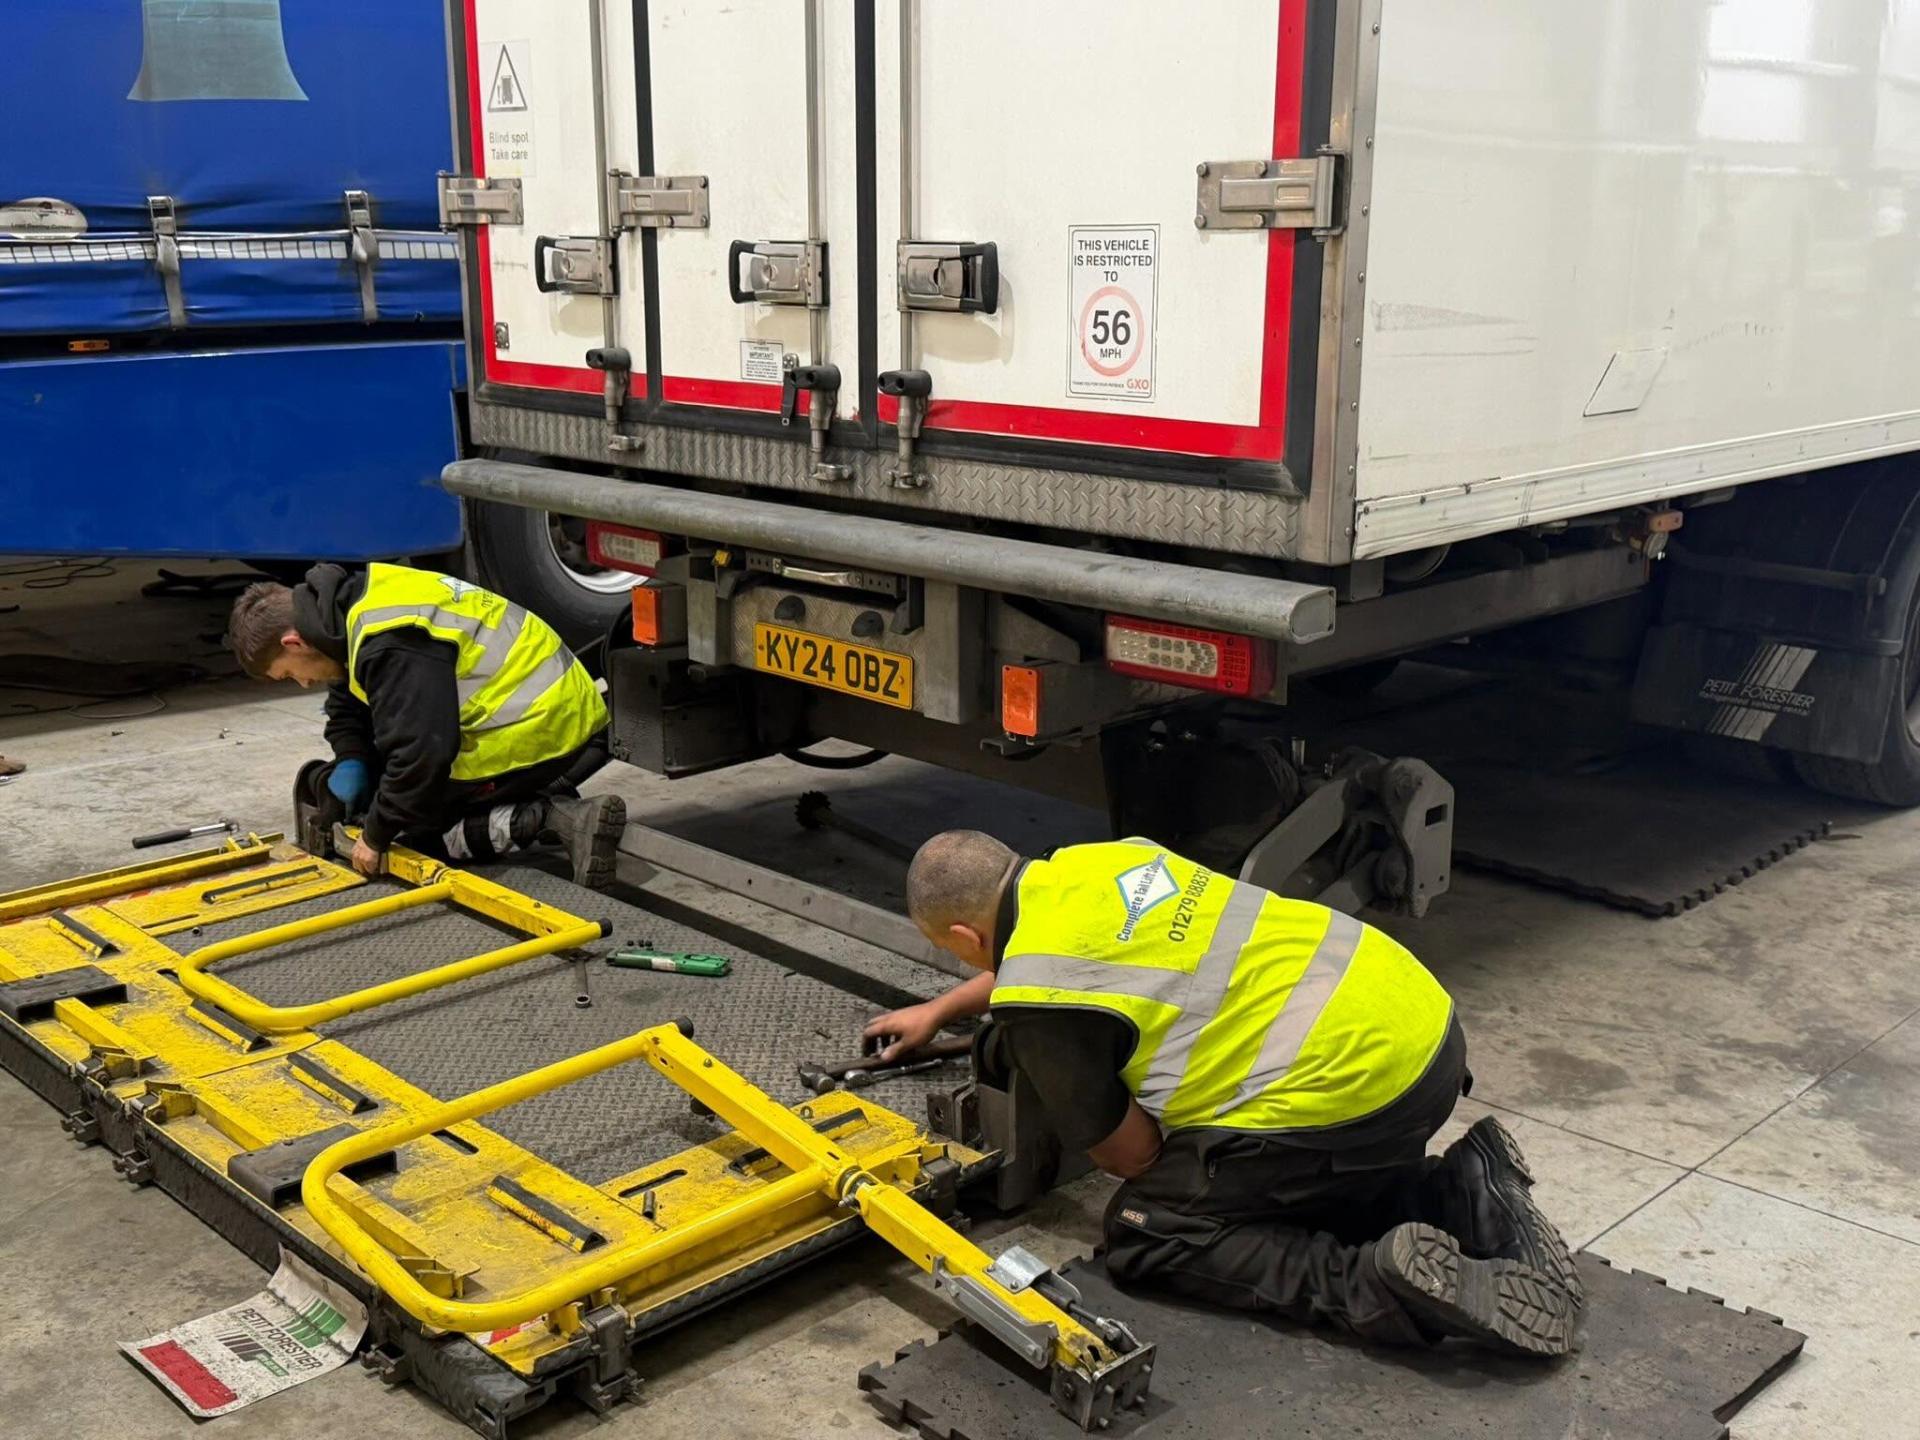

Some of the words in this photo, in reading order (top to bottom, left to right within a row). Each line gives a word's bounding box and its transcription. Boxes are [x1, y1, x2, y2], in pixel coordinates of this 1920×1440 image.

[489, 132, 509, 144] Blind
[511, 132, 528, 147] spot
[491, 149, 509, 160] Take
[511, 150, 528, 160] care
[1078, 240, 1101, 251] THIS
[1104, 239, 1149, 251] VEHICLE
[1074, 255, 1084, 266] IS
[1086, 255, 1152, 266] RESTRICTED
[1104, 271, 1118, 282] TO
[1092, 309, 1131, 345] 56
[1100, 348, 1121, 359] MPH
[1126, 378, 1150, 391] GXO
[766, 630, 836, 682] KY24
[845, 649, 900, 699] OBZ
[1703, 679, 1738, 695] PETIT
[1740, 685, 1816, 708] FORESTIER
[1116, 895, 1144, 942] Complete
[1134, 882, 1150, 896] Tail
[1168, 897, 1199, 942] 01279
[239, 1307, 274, 1330] PETIT
[260, 1328, 324, 1370] FORESTIER
